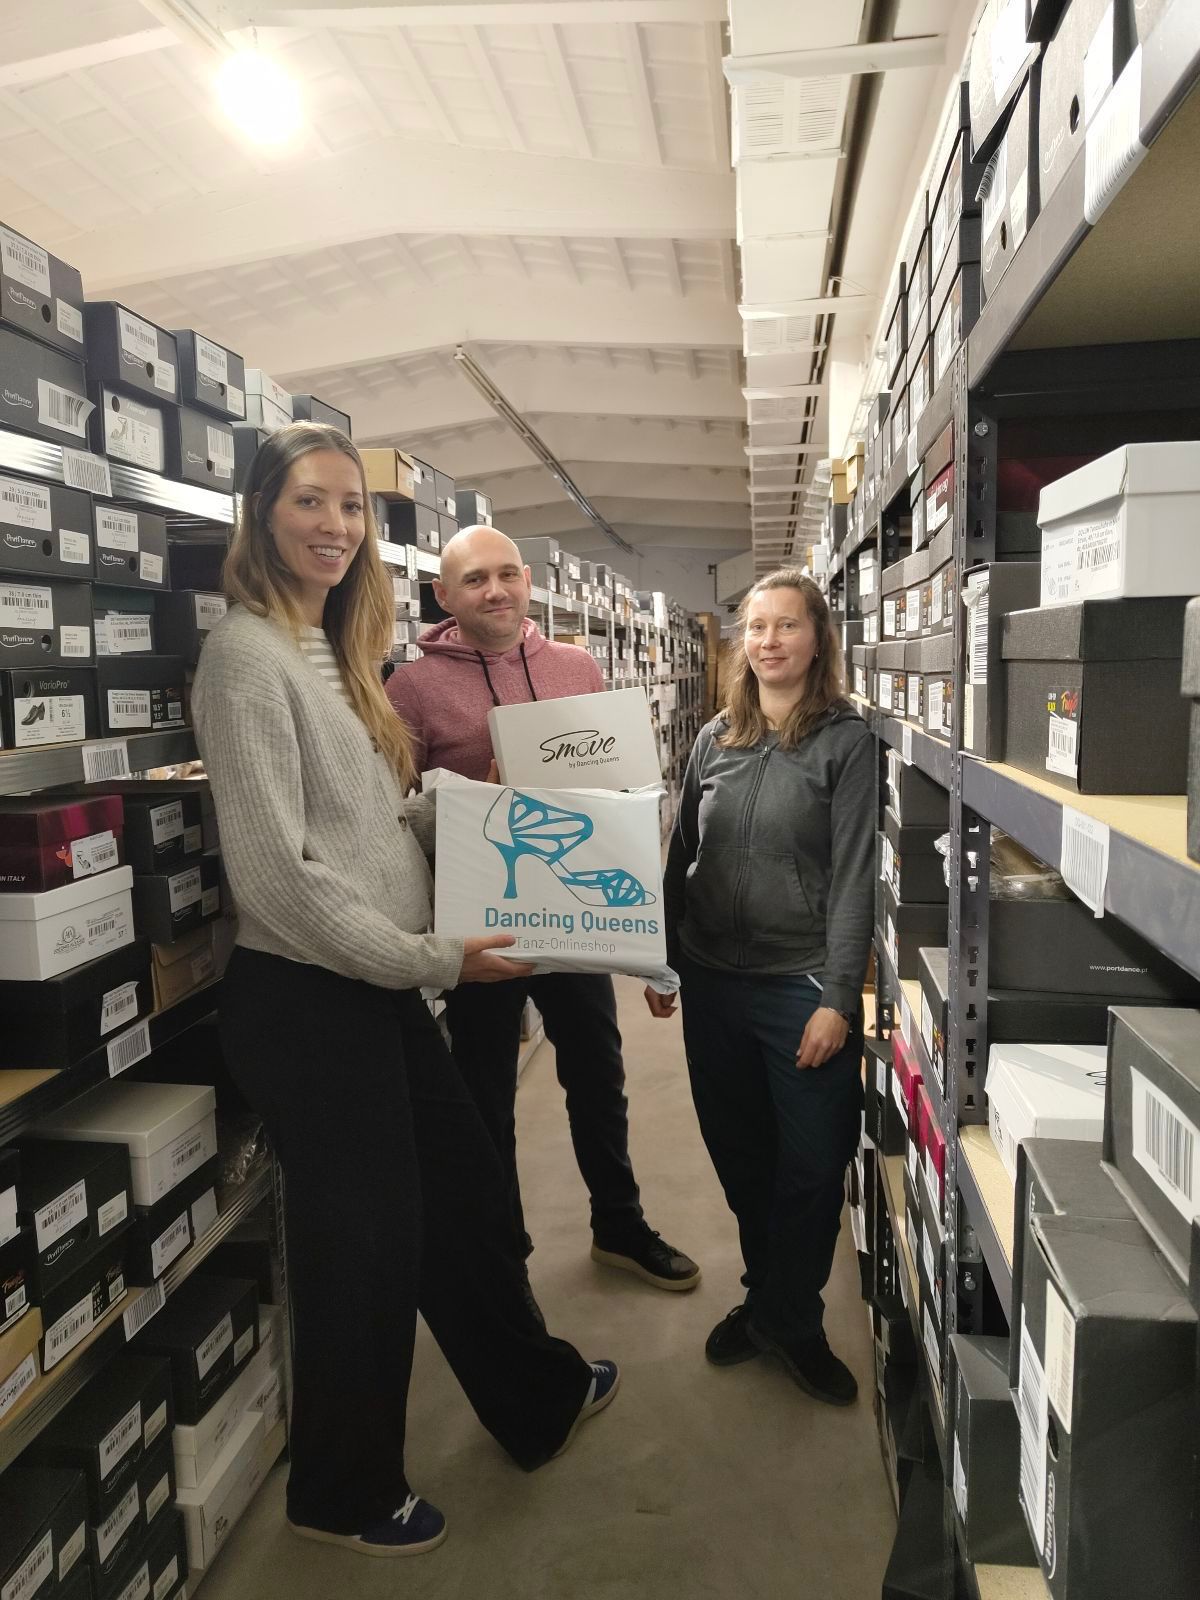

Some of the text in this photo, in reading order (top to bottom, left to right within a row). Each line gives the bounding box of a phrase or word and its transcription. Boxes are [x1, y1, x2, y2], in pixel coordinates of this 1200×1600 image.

[540, 729, 616, 763] Smove
[576, 759, 599, 768] Dancing
[599, 756, 620, 765] Queens
[485, 907, 659, 935] Dancing Queens
[515, 936, 616, 955] Tanz-Onlineshop
